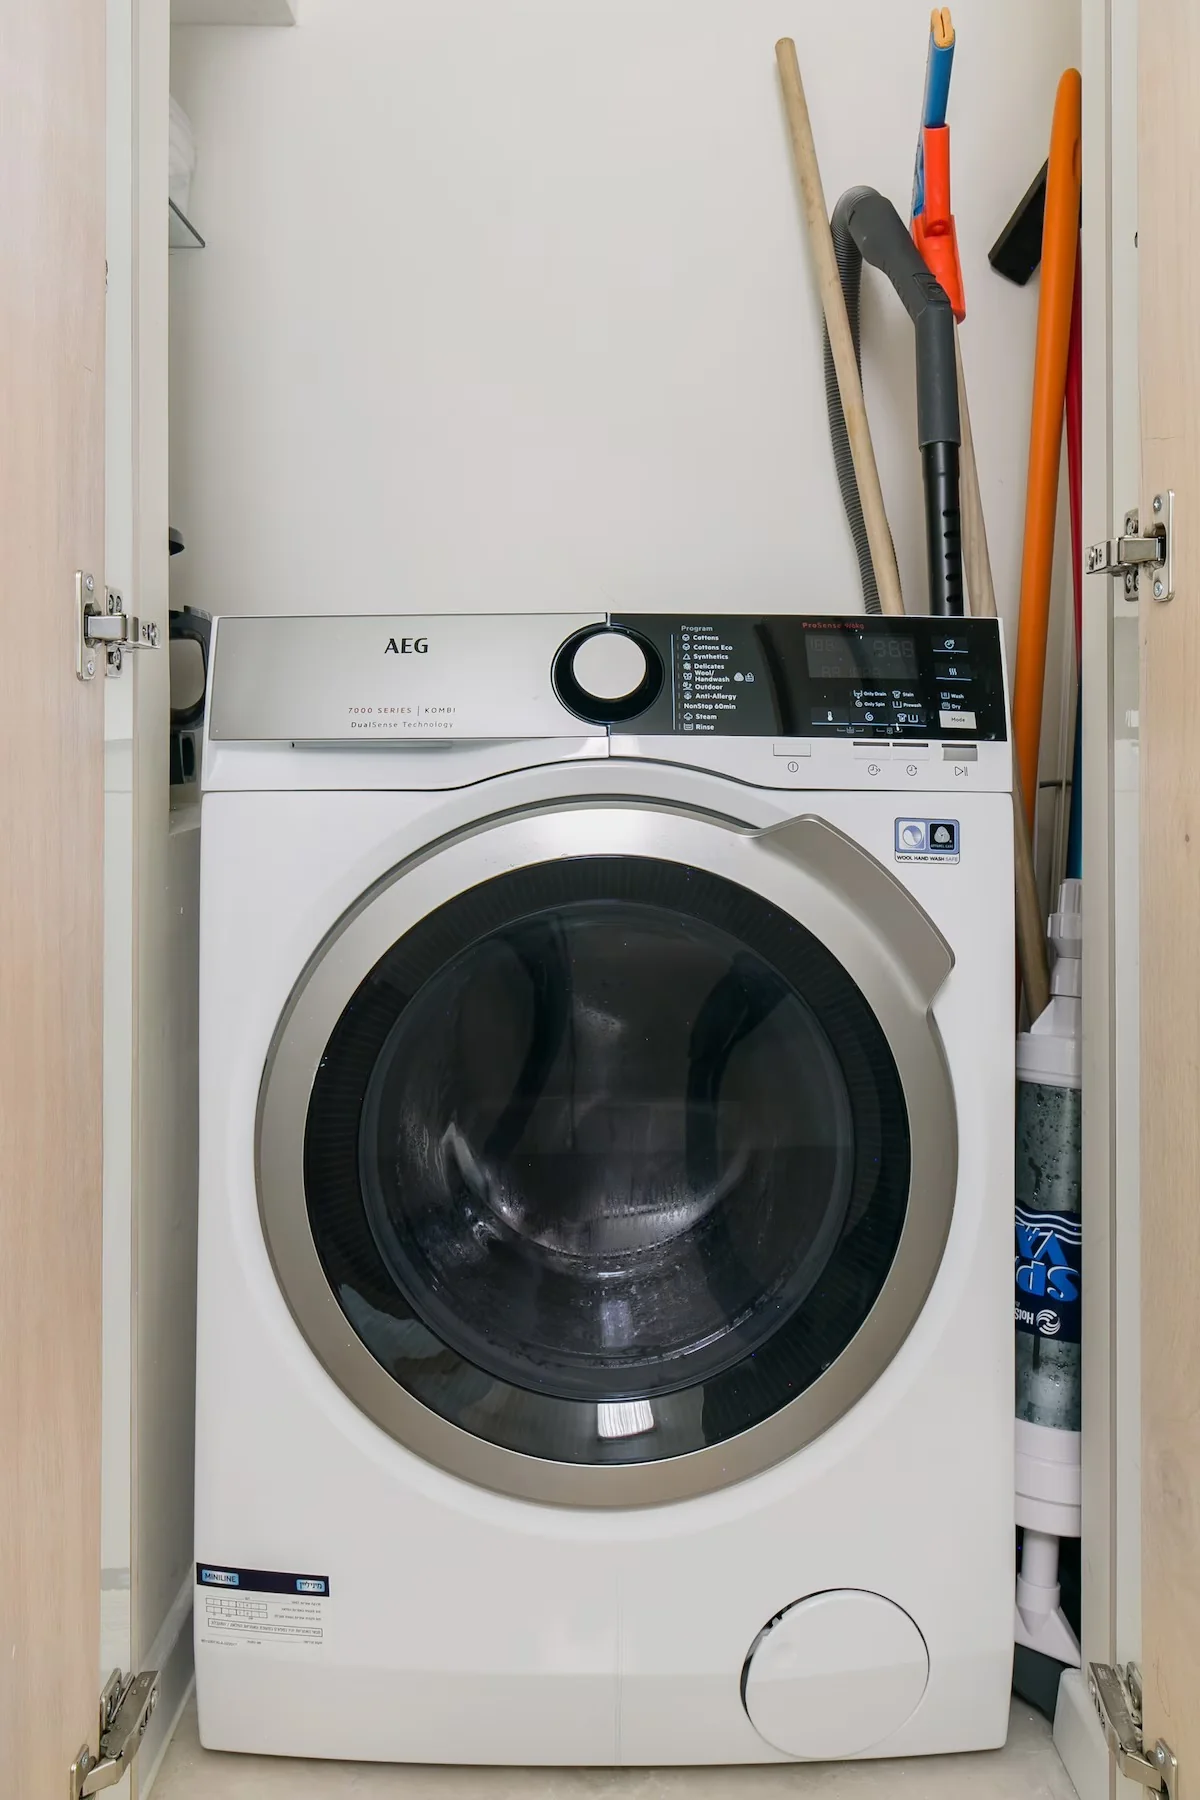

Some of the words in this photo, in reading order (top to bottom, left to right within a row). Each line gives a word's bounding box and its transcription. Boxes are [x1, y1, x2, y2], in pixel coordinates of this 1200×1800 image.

[384, 637, 429, 654] AEG
[402, 721, 454, 729] Technology
[204, 1572, 237, 1584] MINILINE
